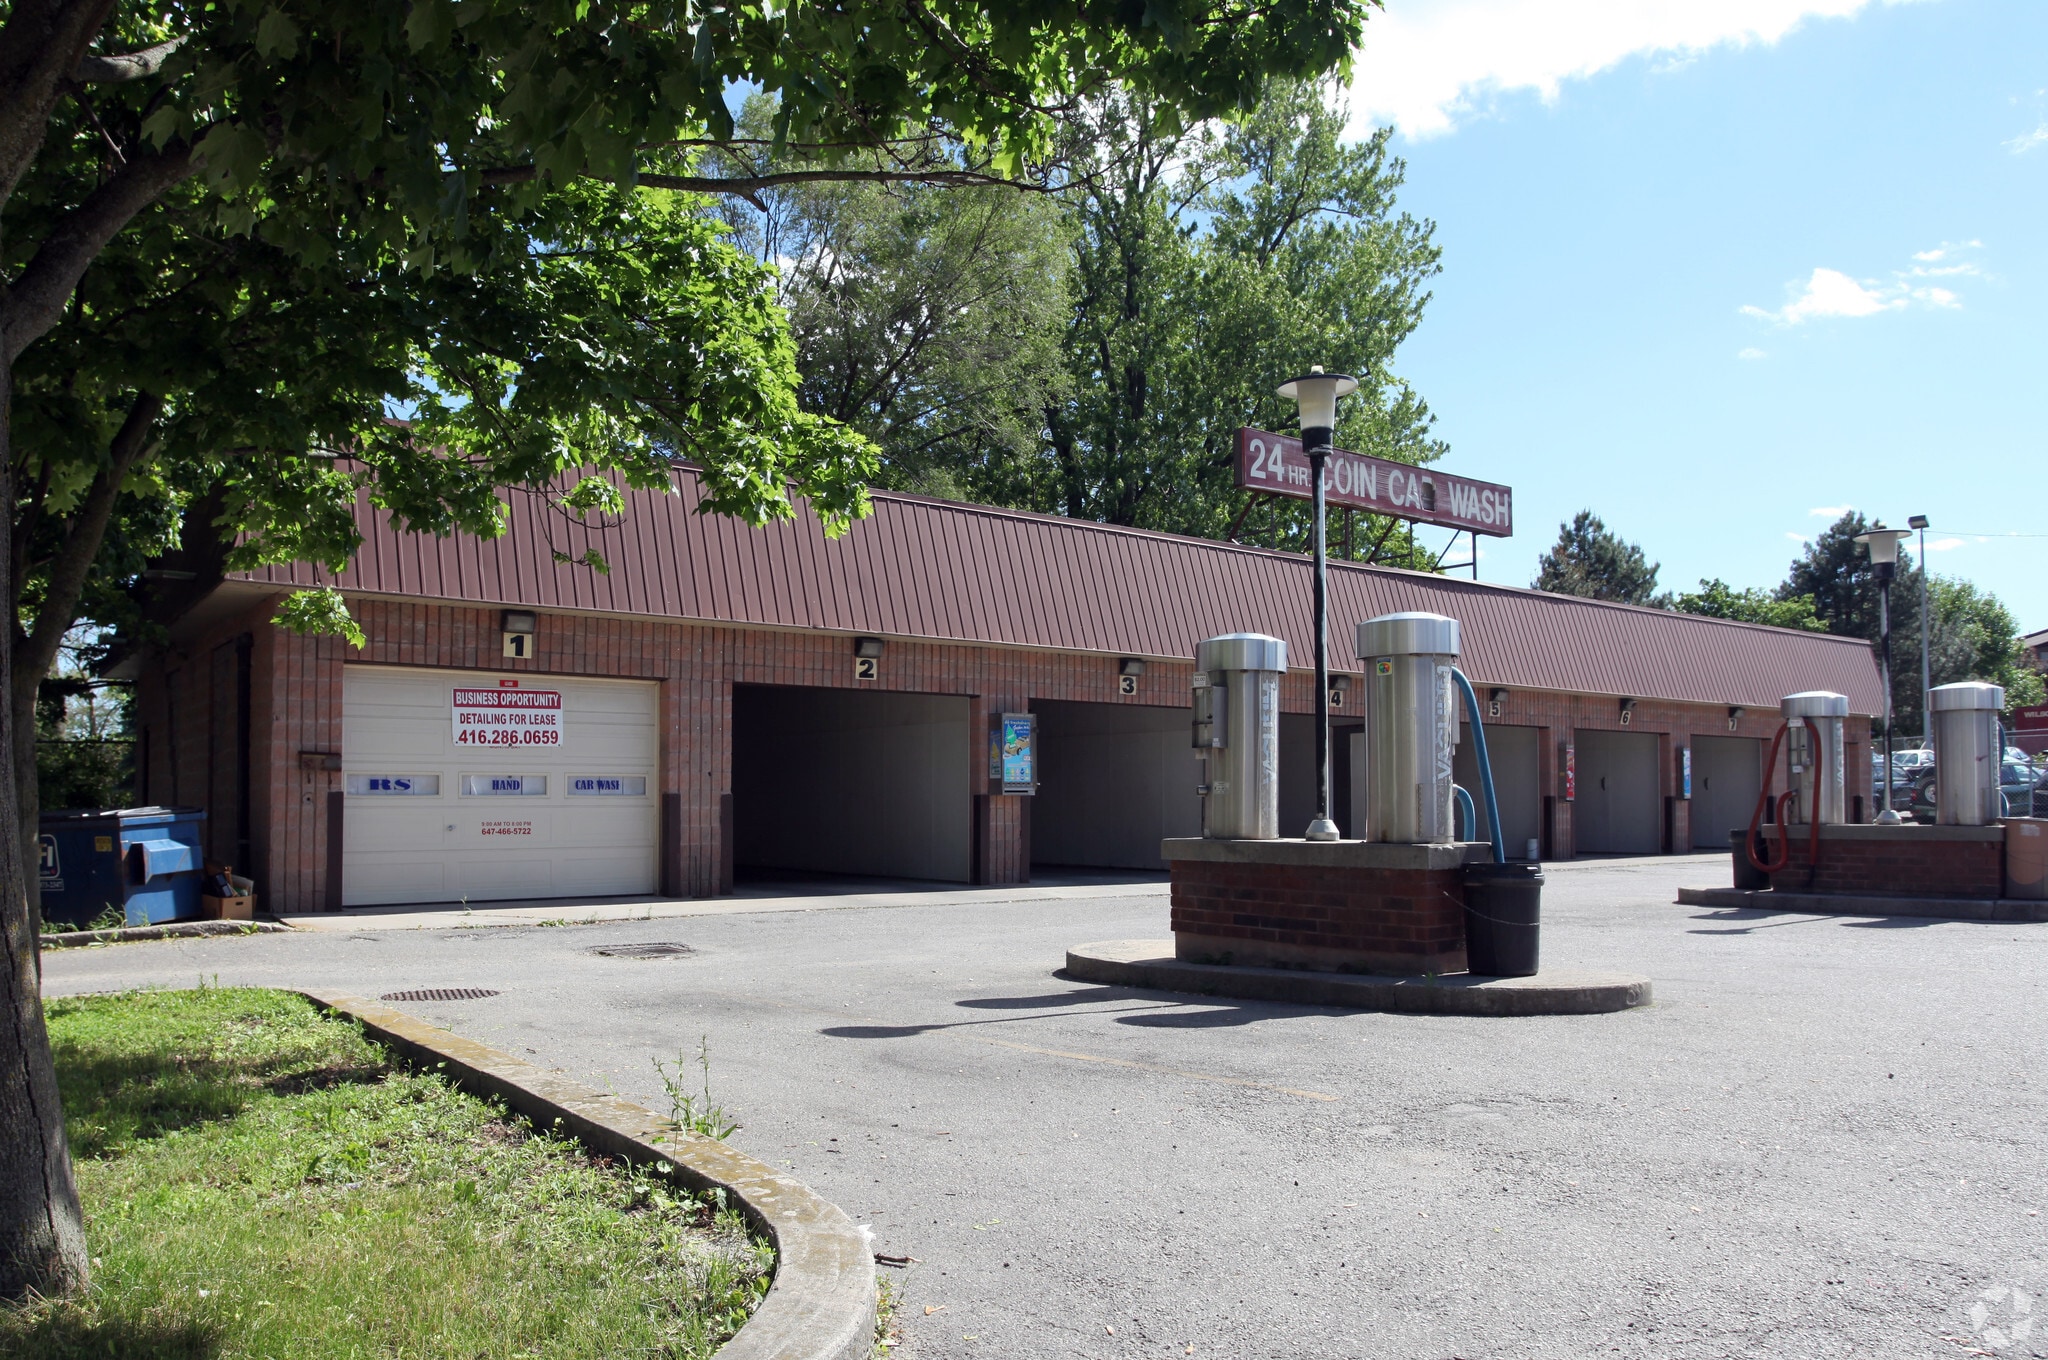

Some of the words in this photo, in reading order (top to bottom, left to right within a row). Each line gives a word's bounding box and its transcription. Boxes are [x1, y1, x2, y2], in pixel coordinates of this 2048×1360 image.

[1249, 438, 1285, 482] 24
[1447, 481, 1509, 527] WASH
[510, 634, 524, 657] 1
[858, 659, 875, 679] 2
[1122, 677, 1135, 694] 3
[455, 691, 499, 706] BUSINESS
[500, 693, 559, 707] OPPORTUNITY
[1330, 691, 1342, 706] 4
[1491, 702, 1499, 716] 5
[460, 712, 507, 725] DETAILING
[509, 713, 527, 725] FOR
[529, 714, 556, 726] LEASE
[1622, 712, 1630, 724] 6
[458, 729, 559, 745] 416.286.0659
[491, 779, 520, 791] HAND
[575, 779, 594, 791] CAR
[481, 827, 532, 836] 647-466-5722
